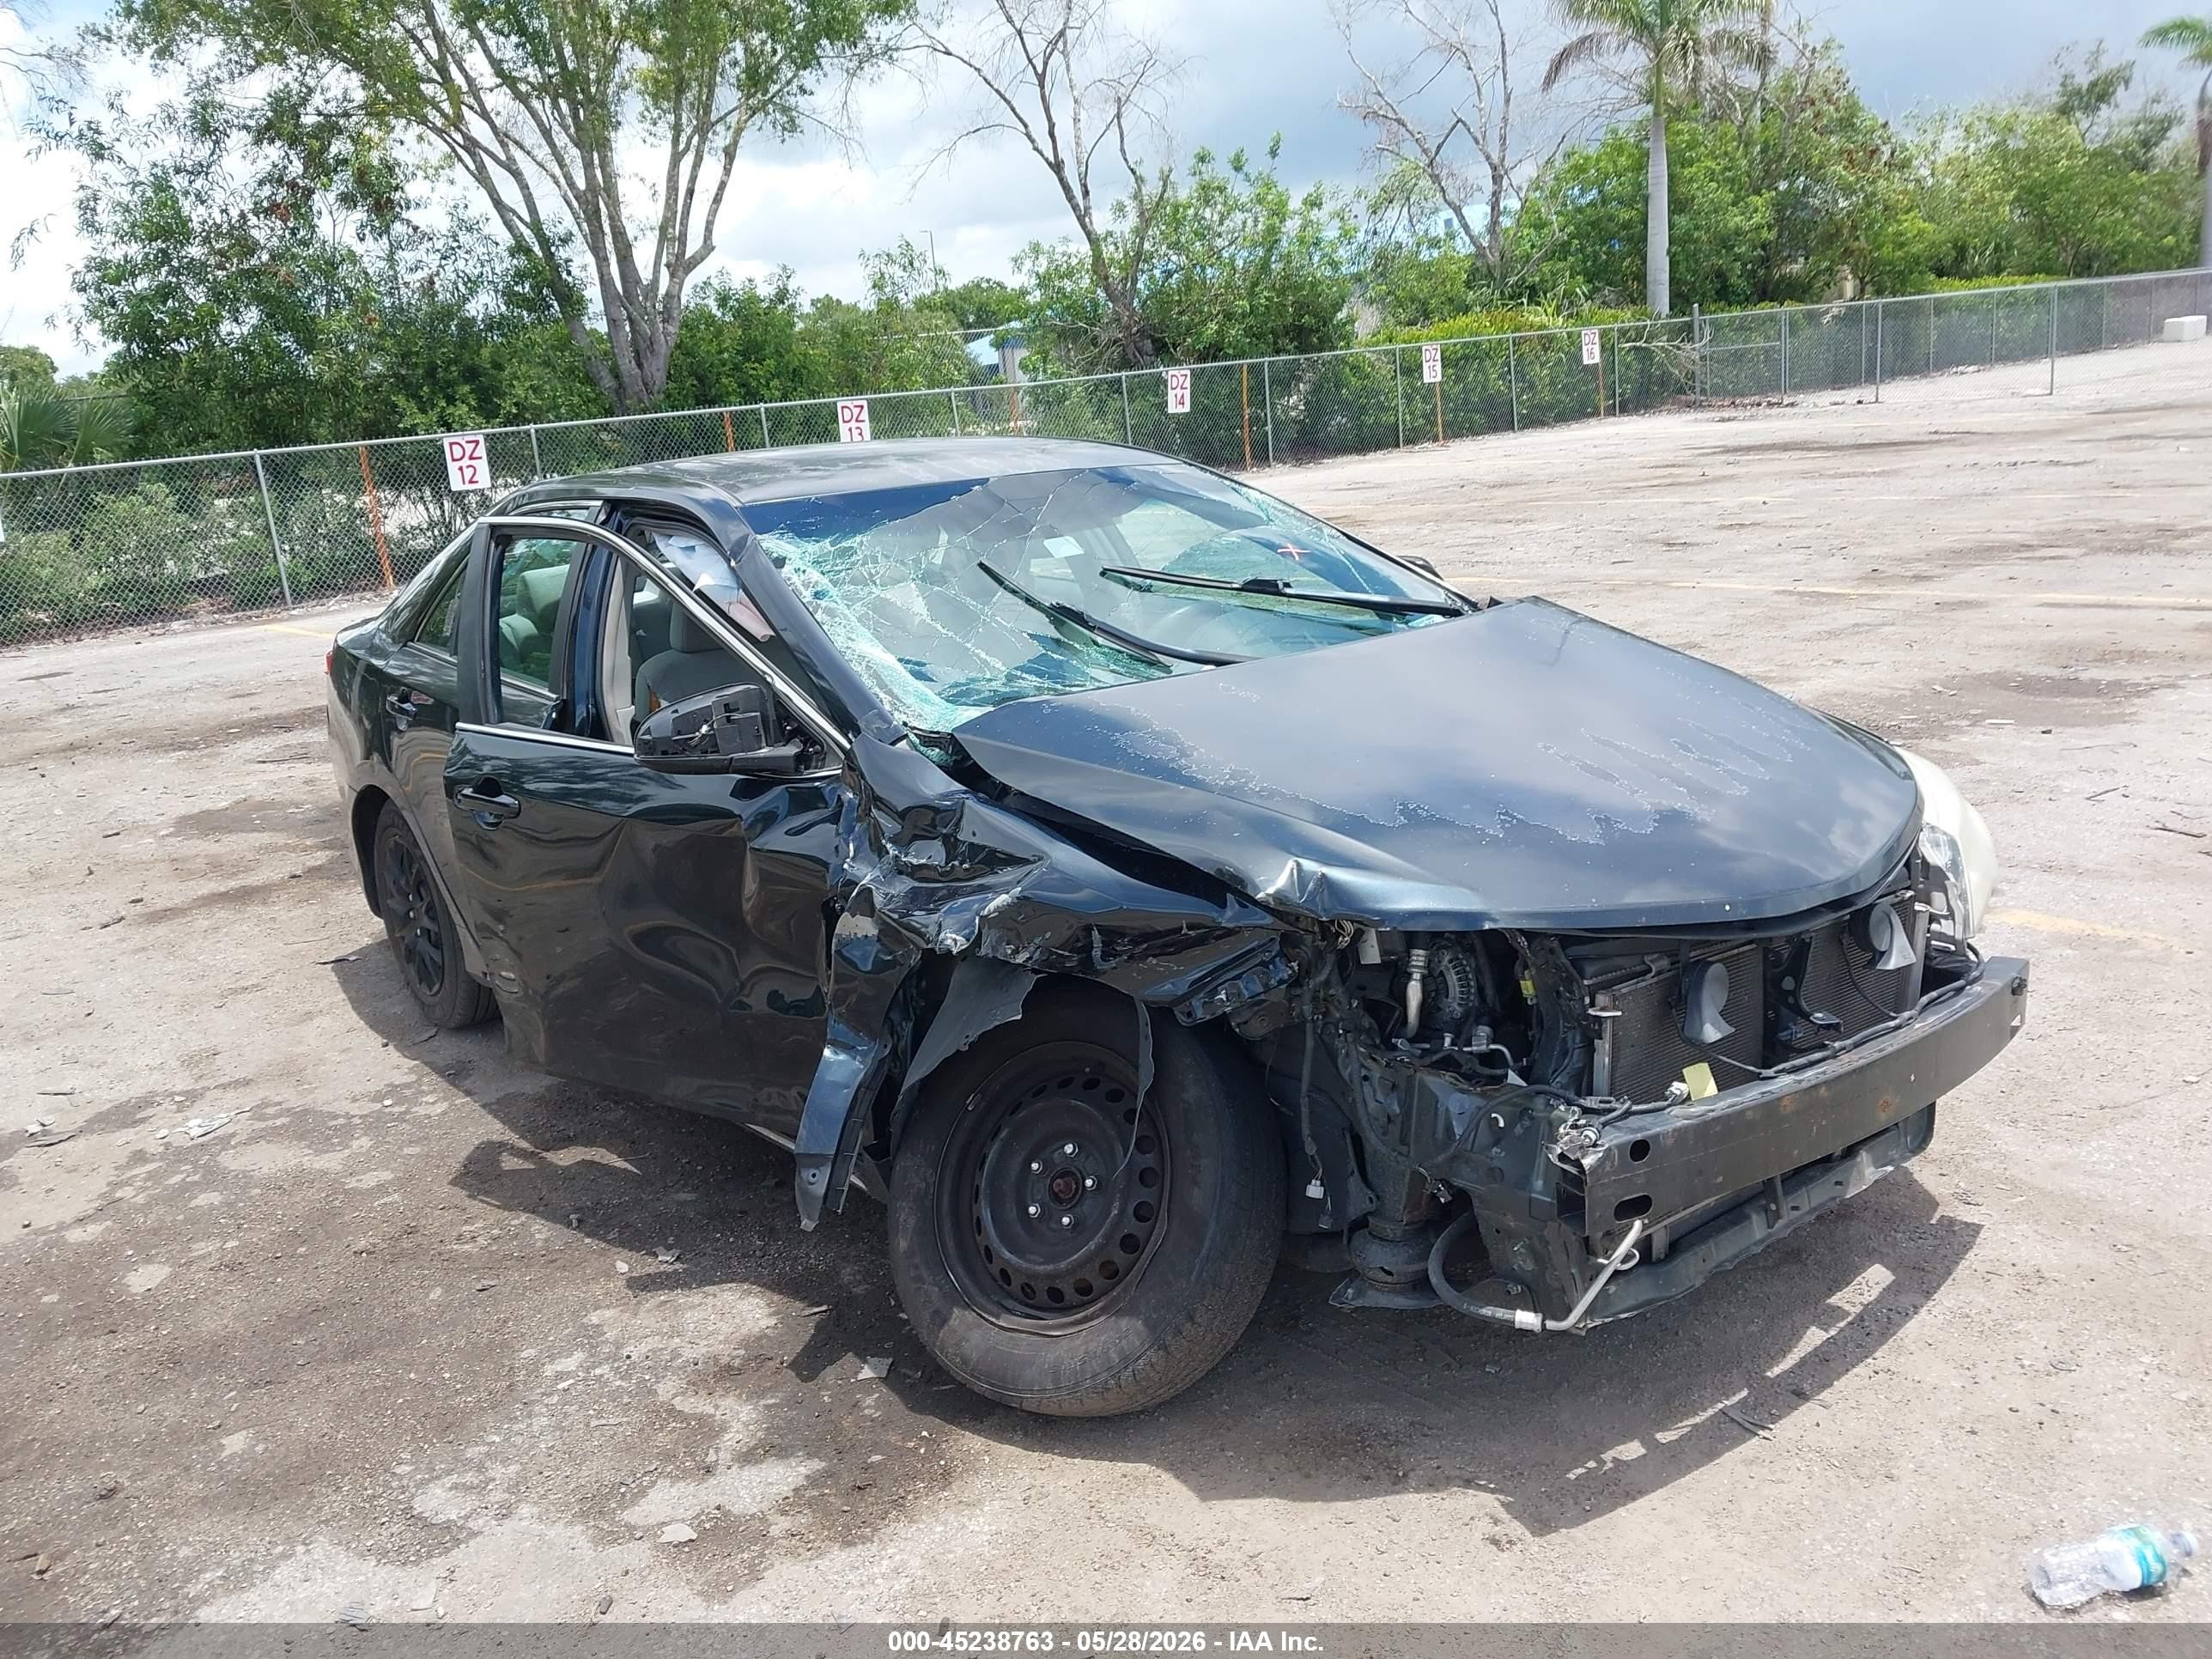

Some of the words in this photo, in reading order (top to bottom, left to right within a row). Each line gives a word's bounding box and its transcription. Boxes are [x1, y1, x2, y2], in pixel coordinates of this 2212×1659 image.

[1583, 331, 1597, 346] DZ
[1425, 348, 1439, 363] DZ
[1586, 347, 1595, 361] 16
[1428, 364, 1438, 380] 15
[1170, 374, 1188, 391] DZ
[1174, 392, 1186, 410] 14
[841, 404, 866, 423] DZ
[848, 426, 865, 442] 13
[448, 439, 483, 462] DZ
[457, 465, 479, 485] 12
